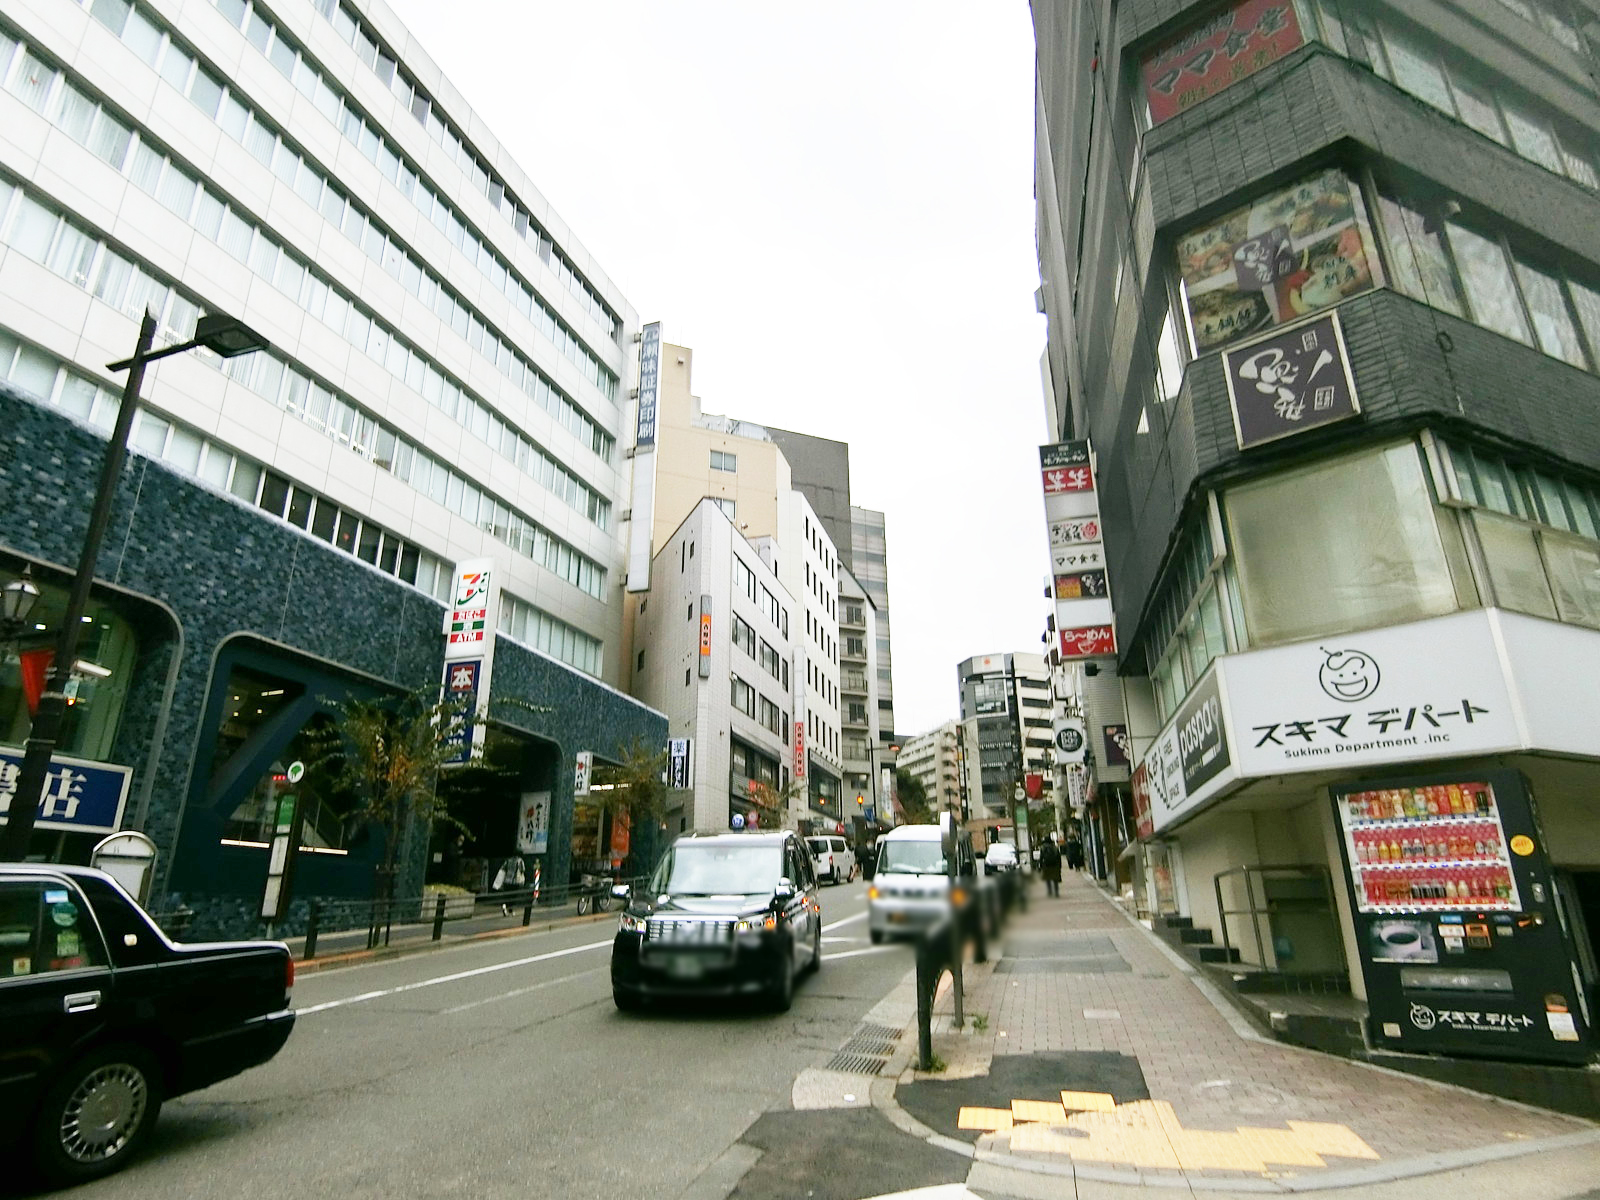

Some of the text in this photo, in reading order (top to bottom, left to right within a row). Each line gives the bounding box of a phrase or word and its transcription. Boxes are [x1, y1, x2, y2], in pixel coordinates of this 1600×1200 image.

[456, 632, 477, 642] ATM
[452, 668, 472, 688] 本
[1253, 698, 1489, 748] スキマ デパート
[1284, 746, 1330, 758] Sukima
[1335, 736, 1418, 752] Department
[1437, 1010, 1481, 1025] スキマ
[1486, 1011, 1534, 1027] デパート
